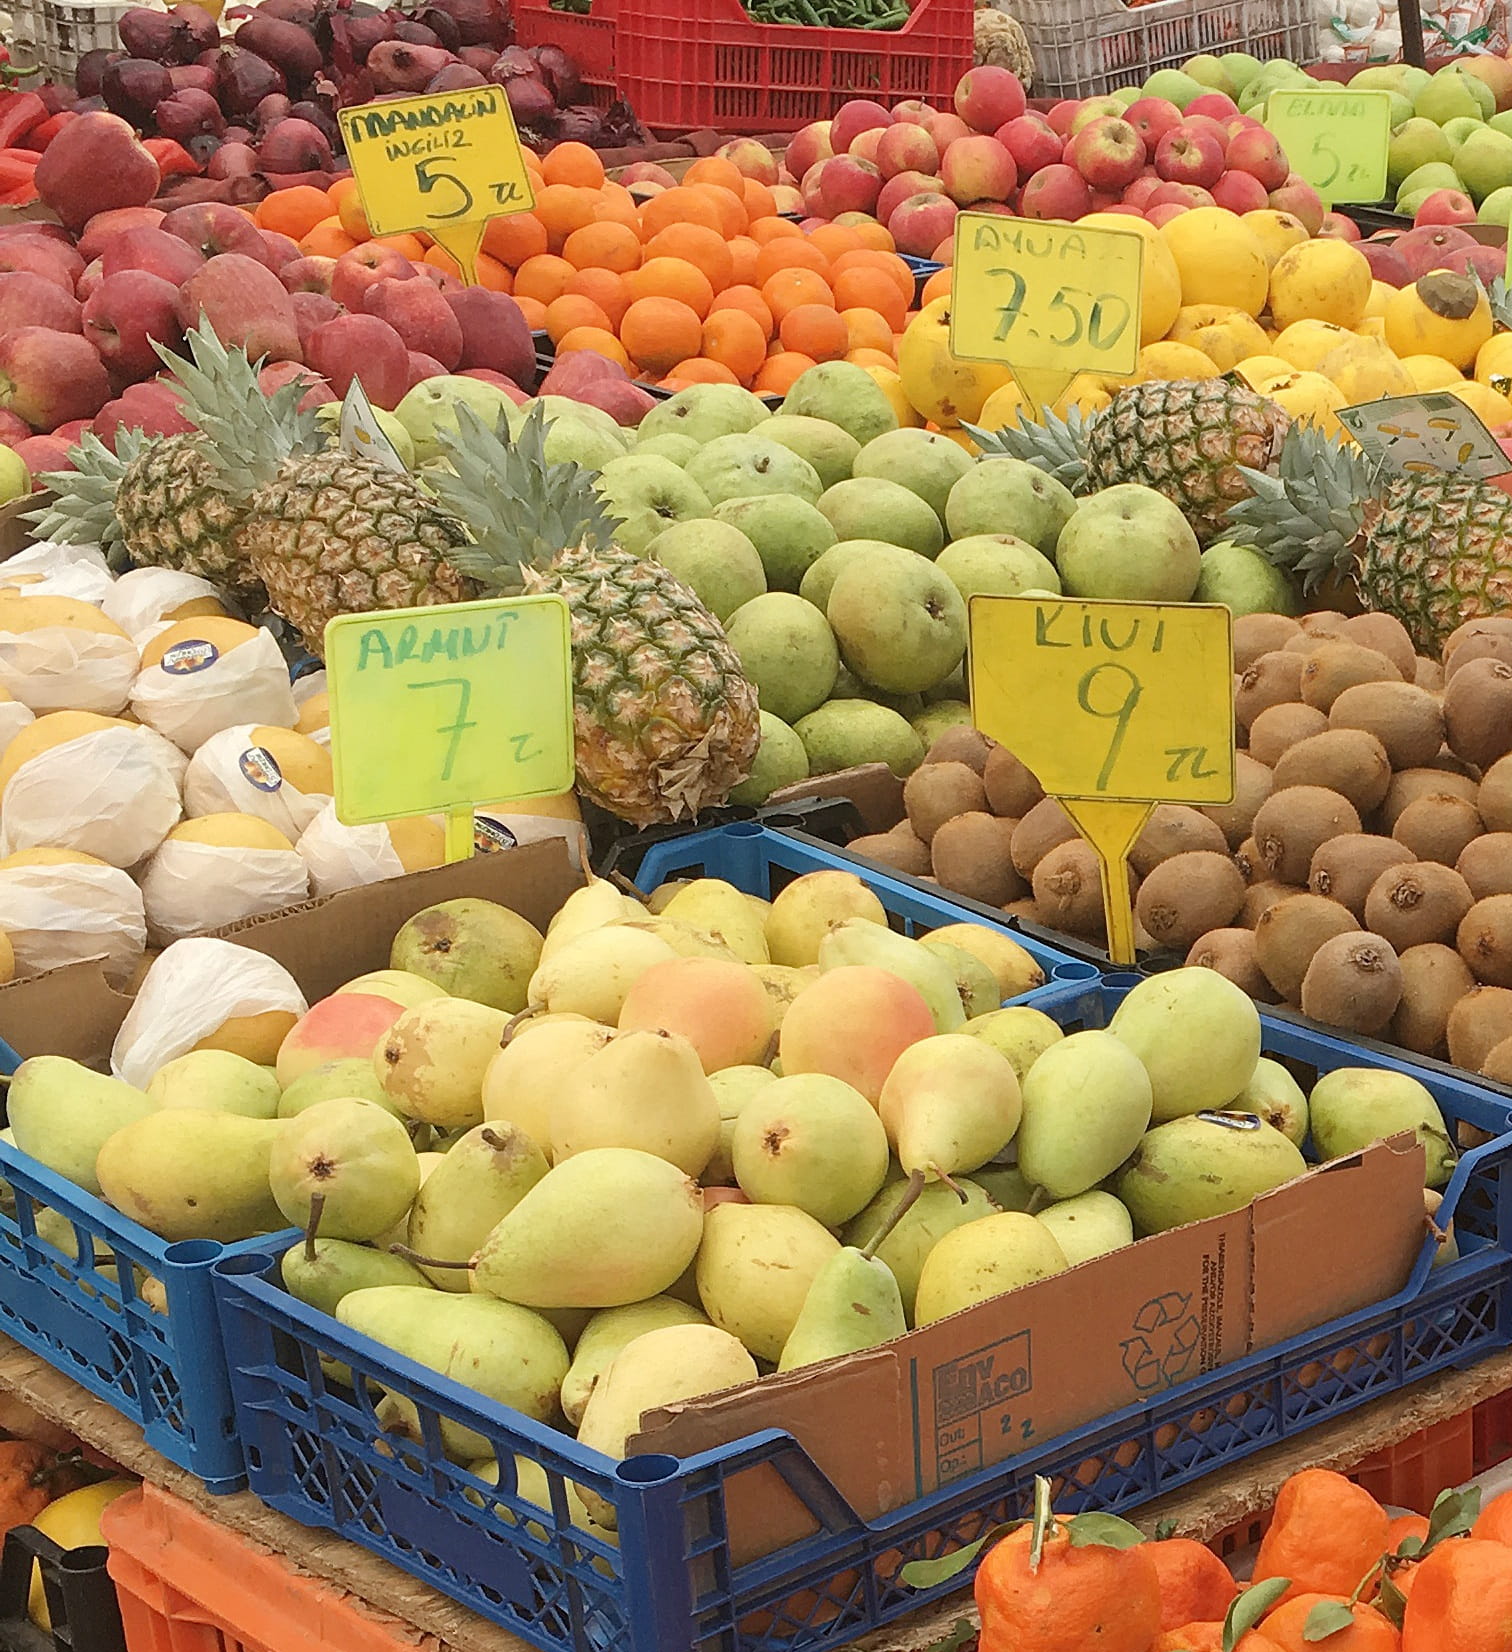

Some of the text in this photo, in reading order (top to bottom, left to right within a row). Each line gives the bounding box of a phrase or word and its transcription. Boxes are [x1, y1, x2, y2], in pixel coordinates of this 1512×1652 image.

[414, 156, 474, 220] 5
[1311, 131, 1341, 189] 5
[984, 267, 1132, 351] 7.50
[356, 611, 520, 672] ARMUT
[407, 677, 478, 782] 7
[1076, 661, 1145, 792] 9
